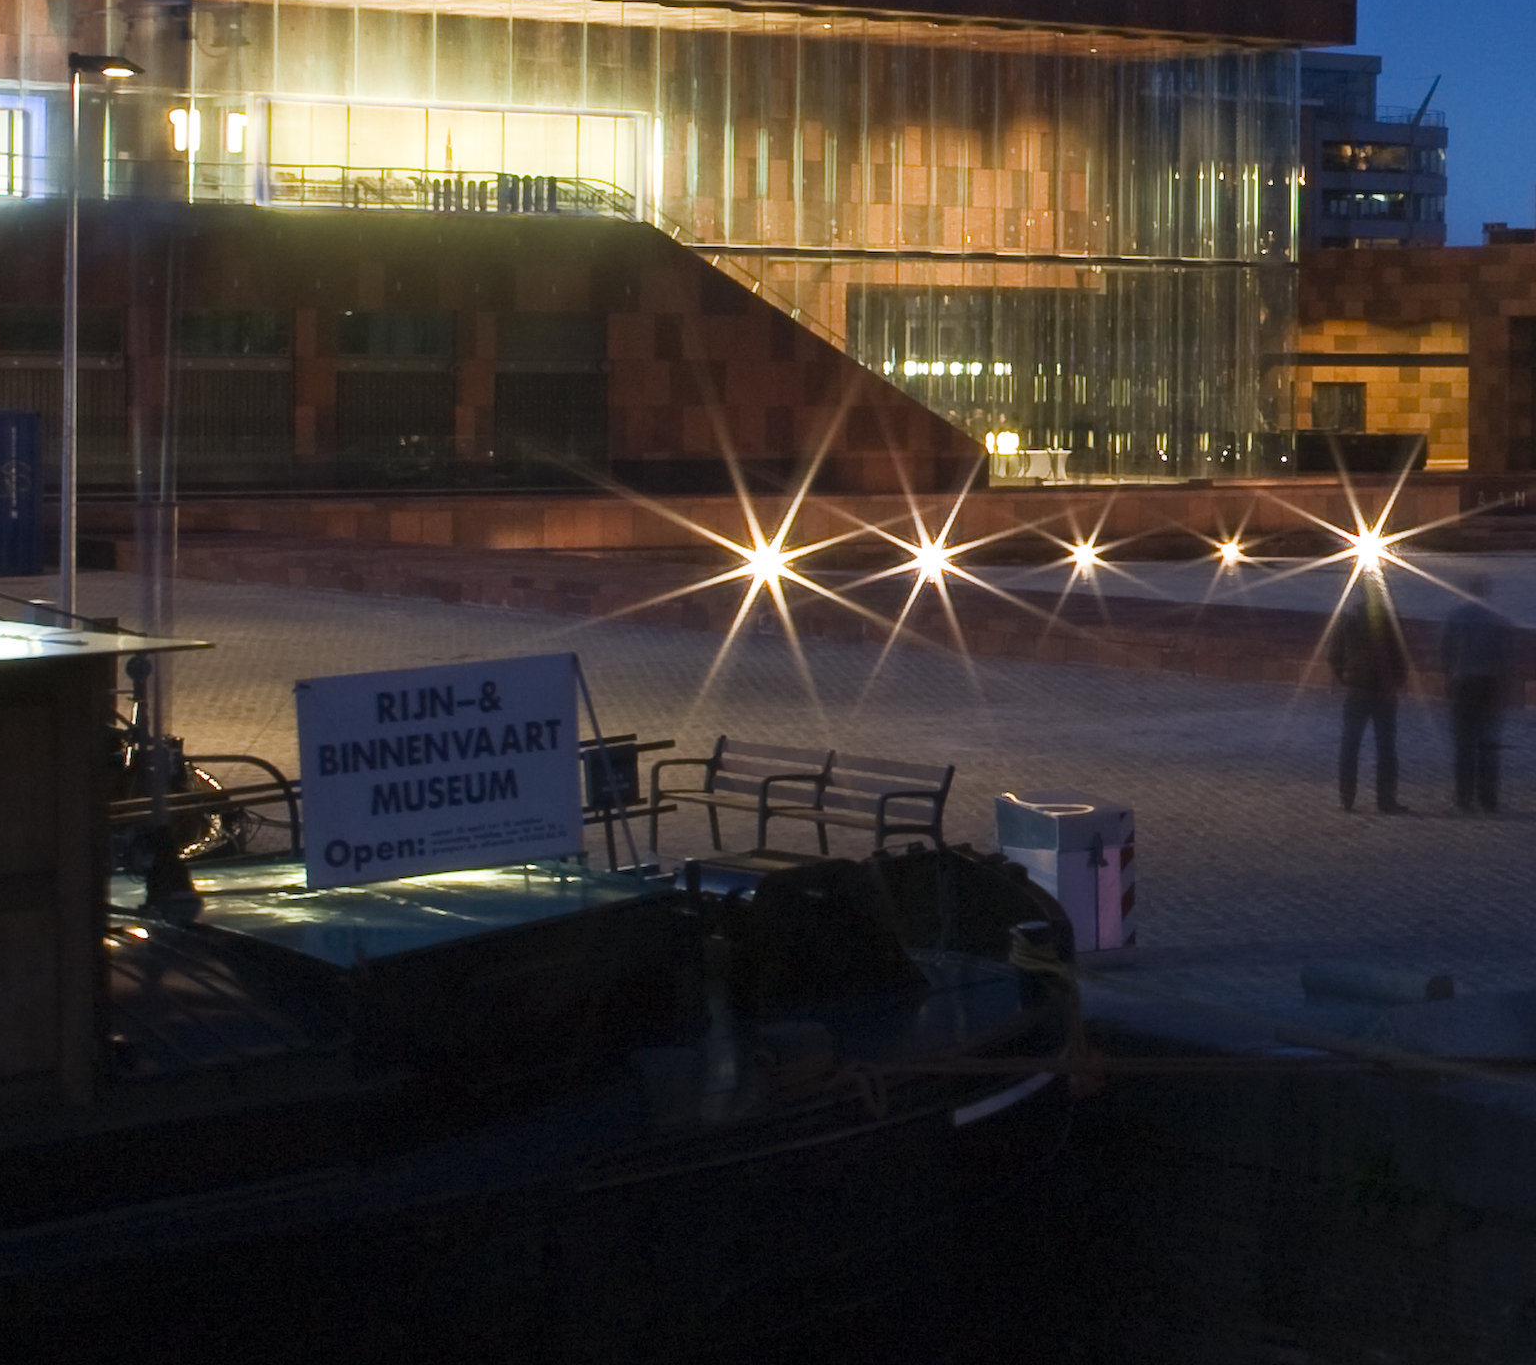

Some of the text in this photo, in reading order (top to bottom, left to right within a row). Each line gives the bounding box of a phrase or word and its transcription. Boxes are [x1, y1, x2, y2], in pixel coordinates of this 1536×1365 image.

[318, 719, 562, 777] BINNENVAART
[371, 769, 519, 816] MUSEUM
[324, 835, 426, 871] Open:
